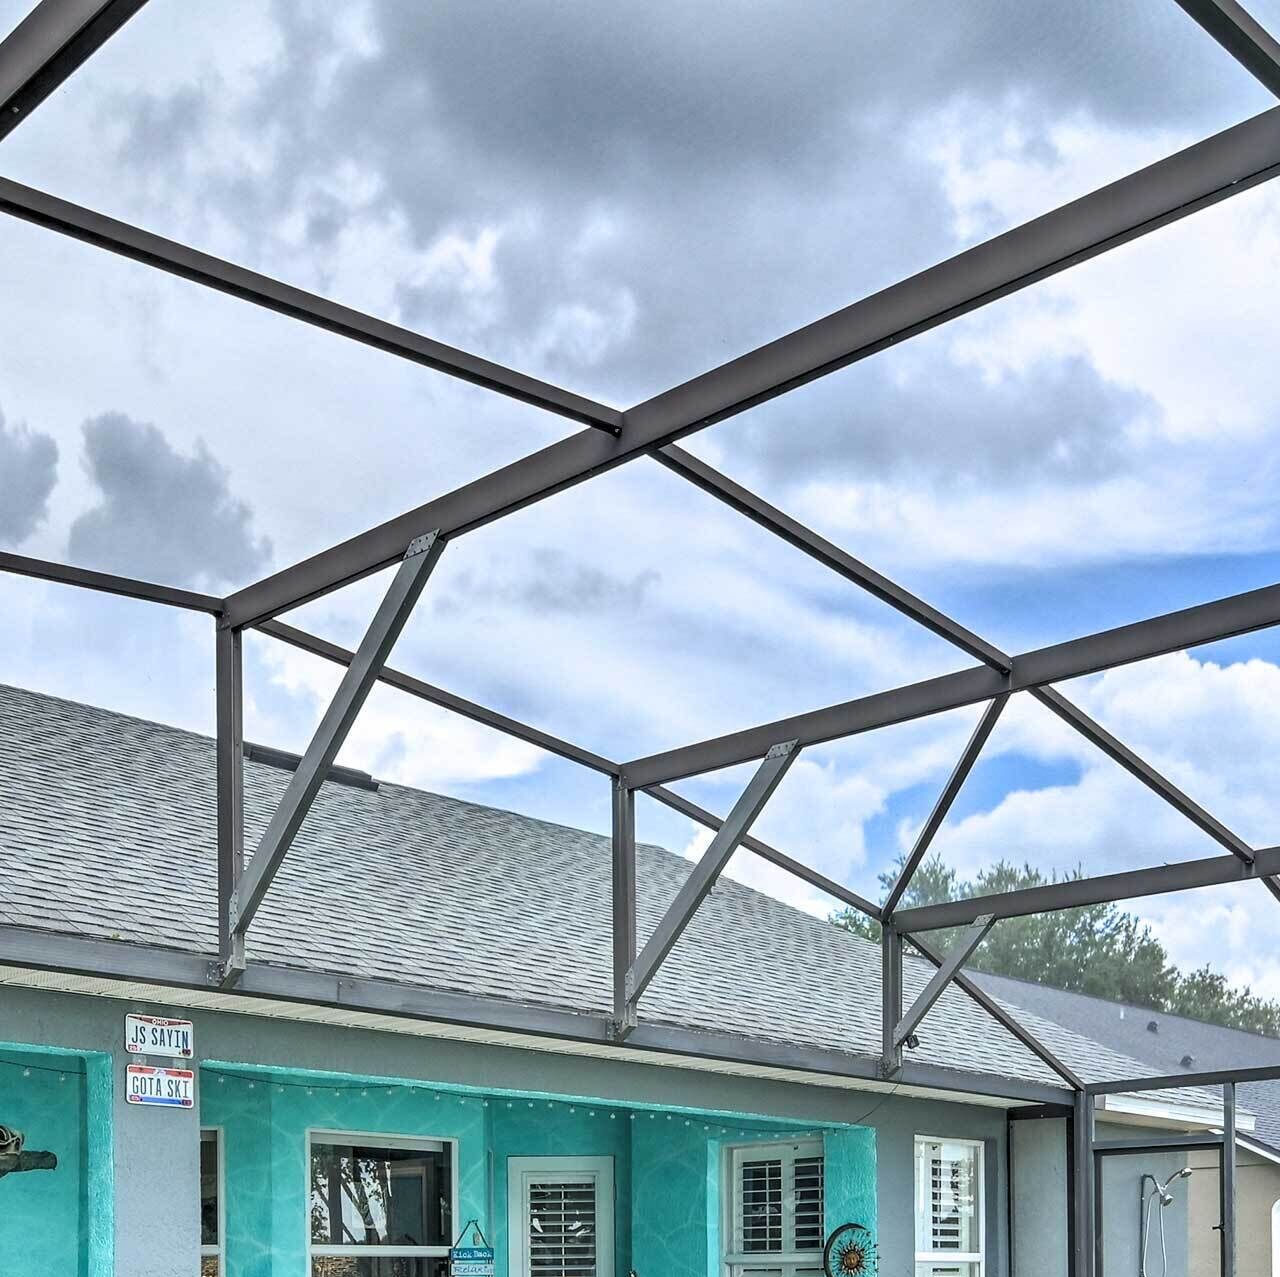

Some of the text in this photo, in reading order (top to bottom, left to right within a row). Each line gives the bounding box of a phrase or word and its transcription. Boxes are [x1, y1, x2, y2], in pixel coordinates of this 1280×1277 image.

[132, 1025, 189, 1049] JS SAYIN
[132, 1076, 189, 1099] GOTA SKI
